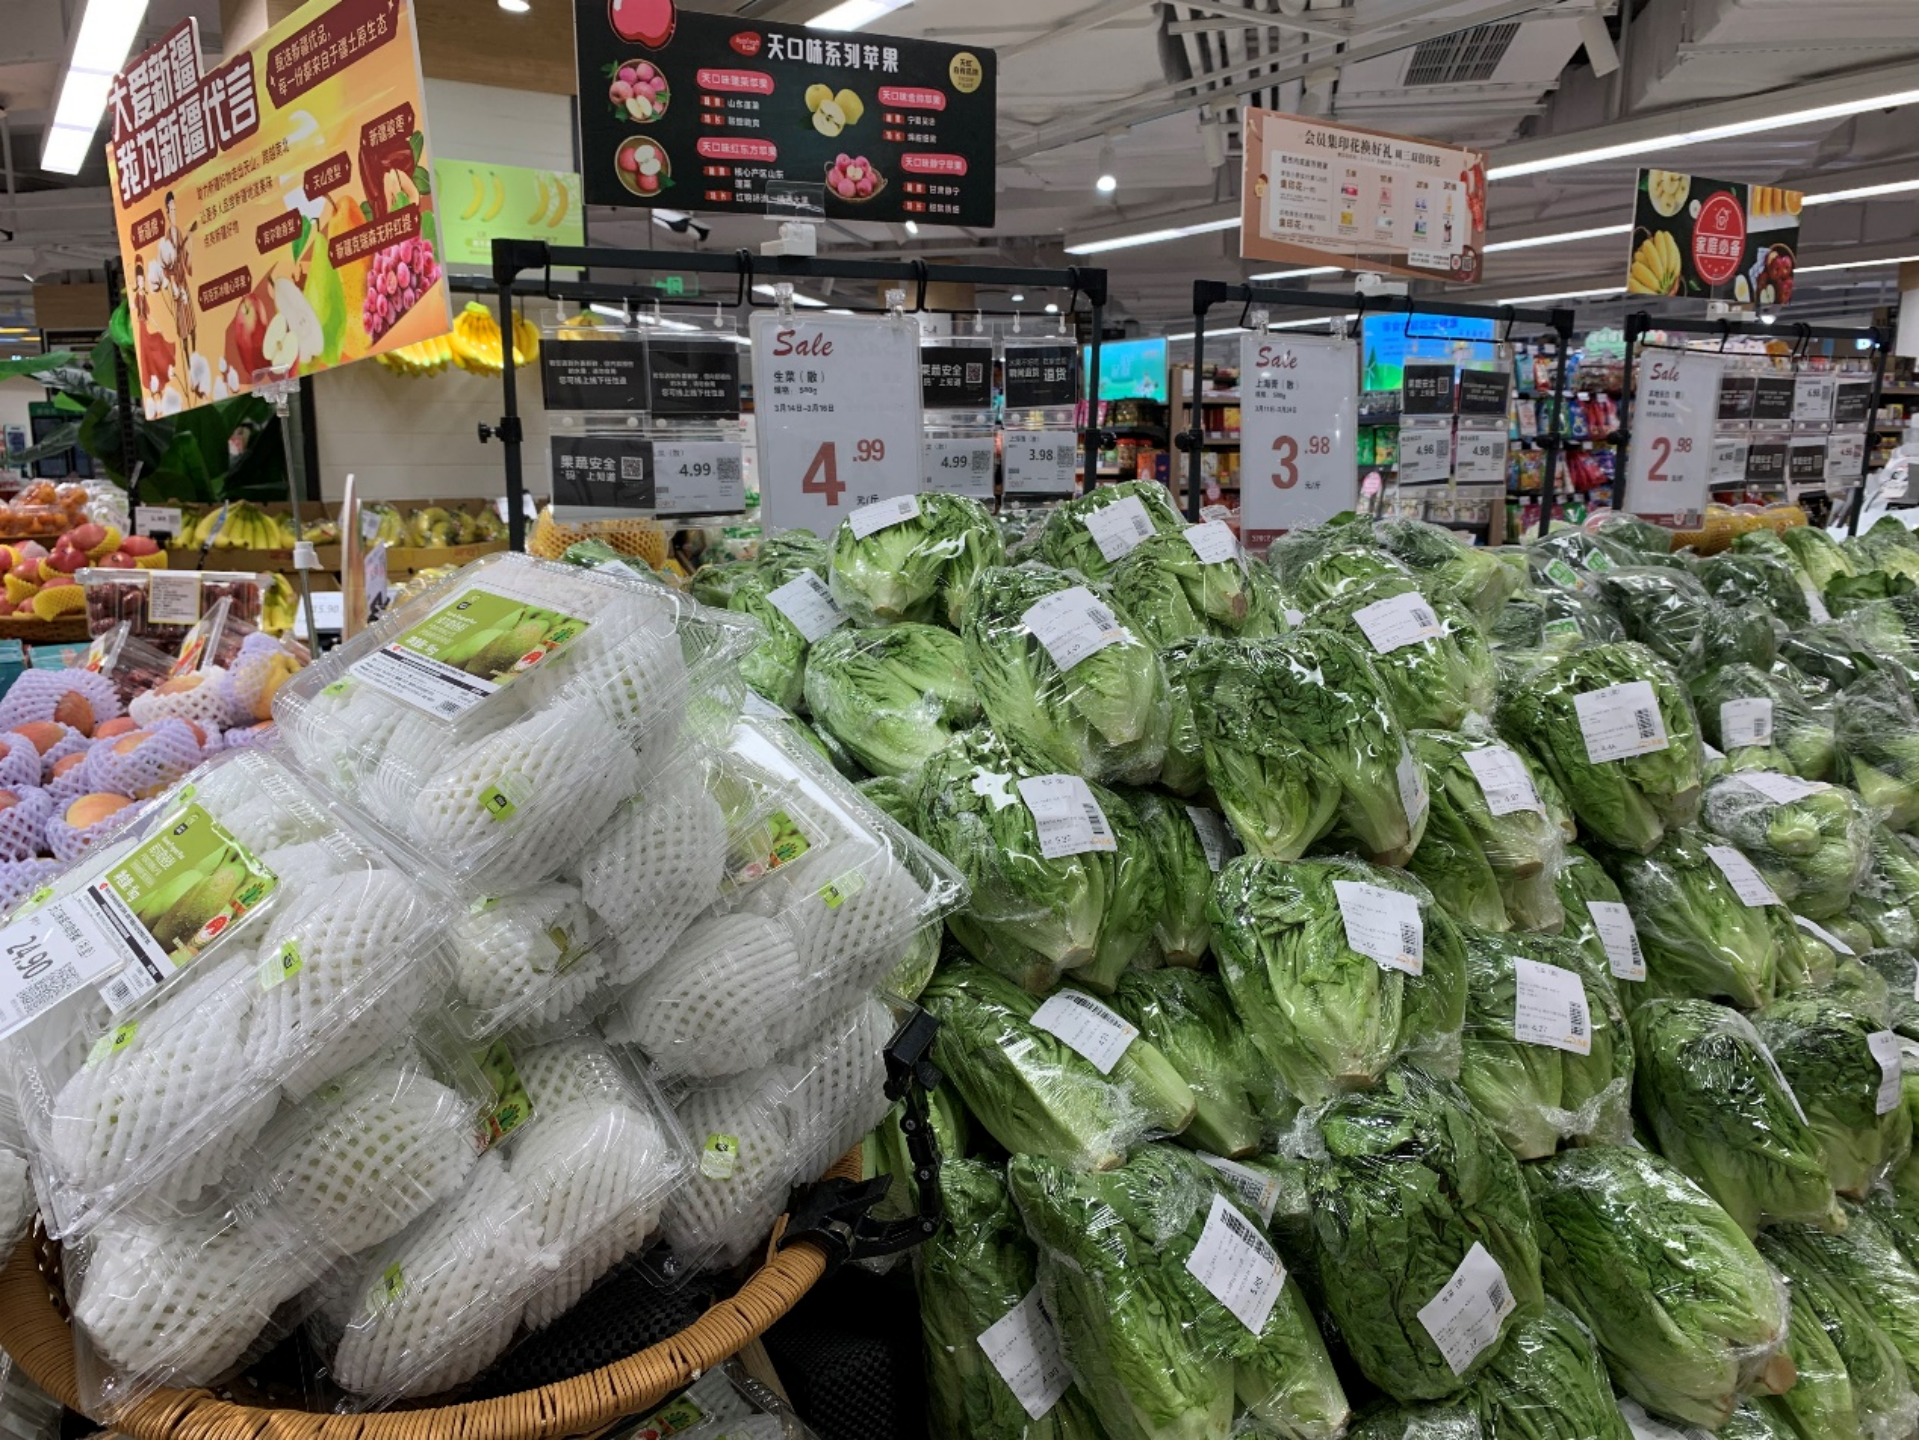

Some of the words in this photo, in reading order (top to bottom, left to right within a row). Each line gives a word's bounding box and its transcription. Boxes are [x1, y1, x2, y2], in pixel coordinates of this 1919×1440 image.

[767, 33, 899, 73] 天口味系列苹果
[109, 26, 198, 142] 大爱新疆
[116, 62, 257, 202] 我为新疆代言
[1304, 130, 1393, 159] 会员集印花换好礼
[1695, 236, 1741, 257] 家庭必备
[772, 329, 834, 357] Sale
[1255, 346, 1298, 369] Sale
[1650, 363, 1680, 382] Sale
[560, 455, 616, 471] 果蔬安全
[940, 456, 968, 469] 4.99
[1029, 449, 1054, 461] 3.98
[1271, 435, 1299, 490] 3
[1647, 436, 1672, 482] 2
[679, 462, 712, 477] 4.99
[802, 441, 846, 506] 4
[6, 935, 54, 981] 24.90
